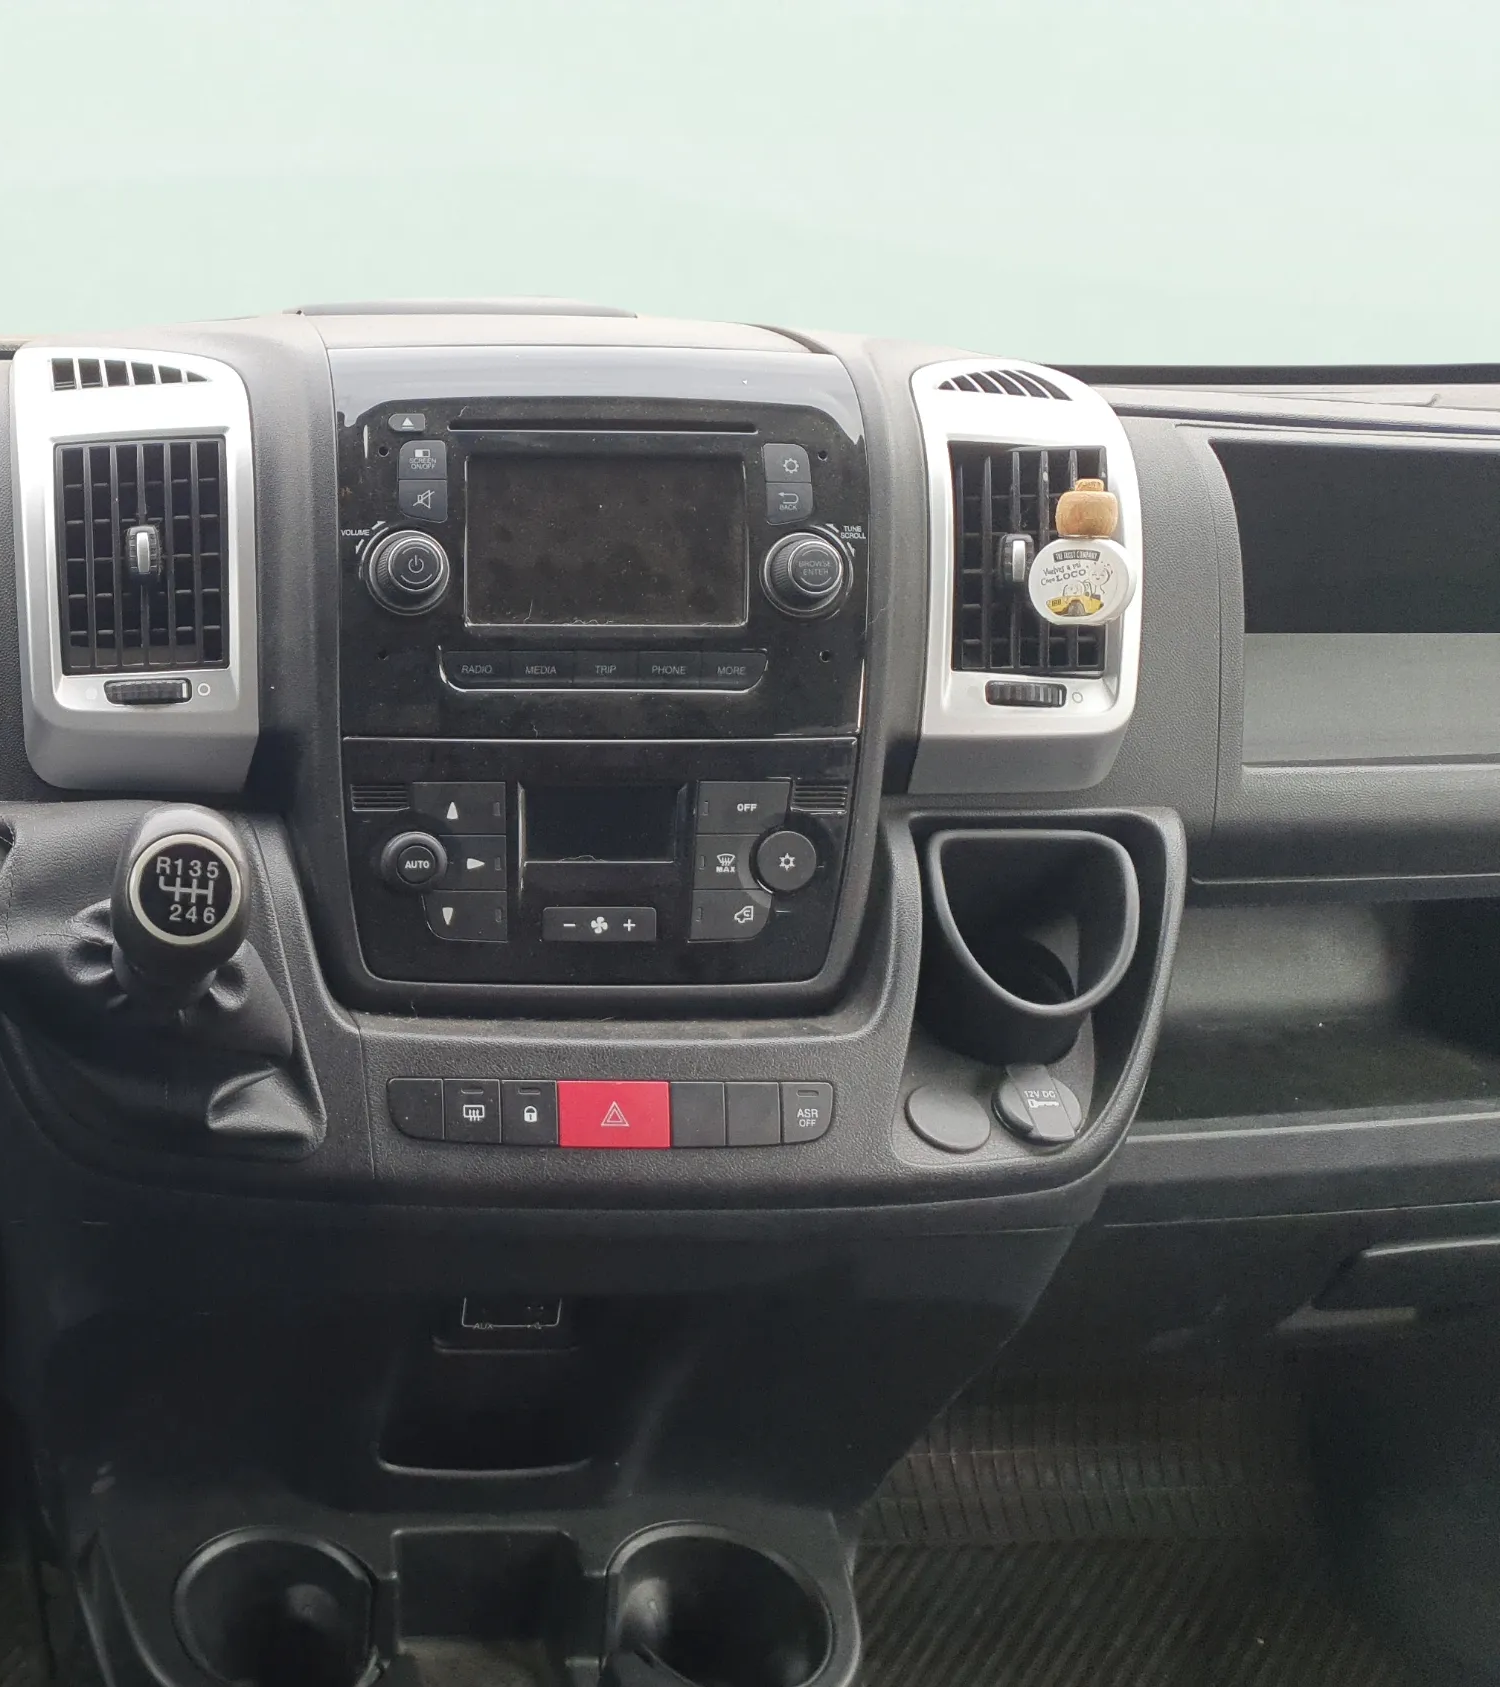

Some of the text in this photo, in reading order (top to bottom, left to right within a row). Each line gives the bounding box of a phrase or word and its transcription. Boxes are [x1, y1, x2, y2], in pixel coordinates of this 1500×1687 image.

[803, 568, 829, 576] ENTER
[1056, 568, 1087, 582] LOCO
[461, 664, 492, 675] RADIO
[525, 664, 557, 675] MEDIA
[595, 664, 616, 675] TRIP
[652, 664, 687, 675] PHONE
[717, 664, 746, 675] MORE
[737, 803, 757, 812] OFF
[404, 860, 430, 869] AUTO
[1023, 1090, 1056, 1098] 12V DC
[796, 1108, 818, 1118] ASR
[798, 1119, 816, 1127] OFF
[473, 1322, 494, 1330] AUX
